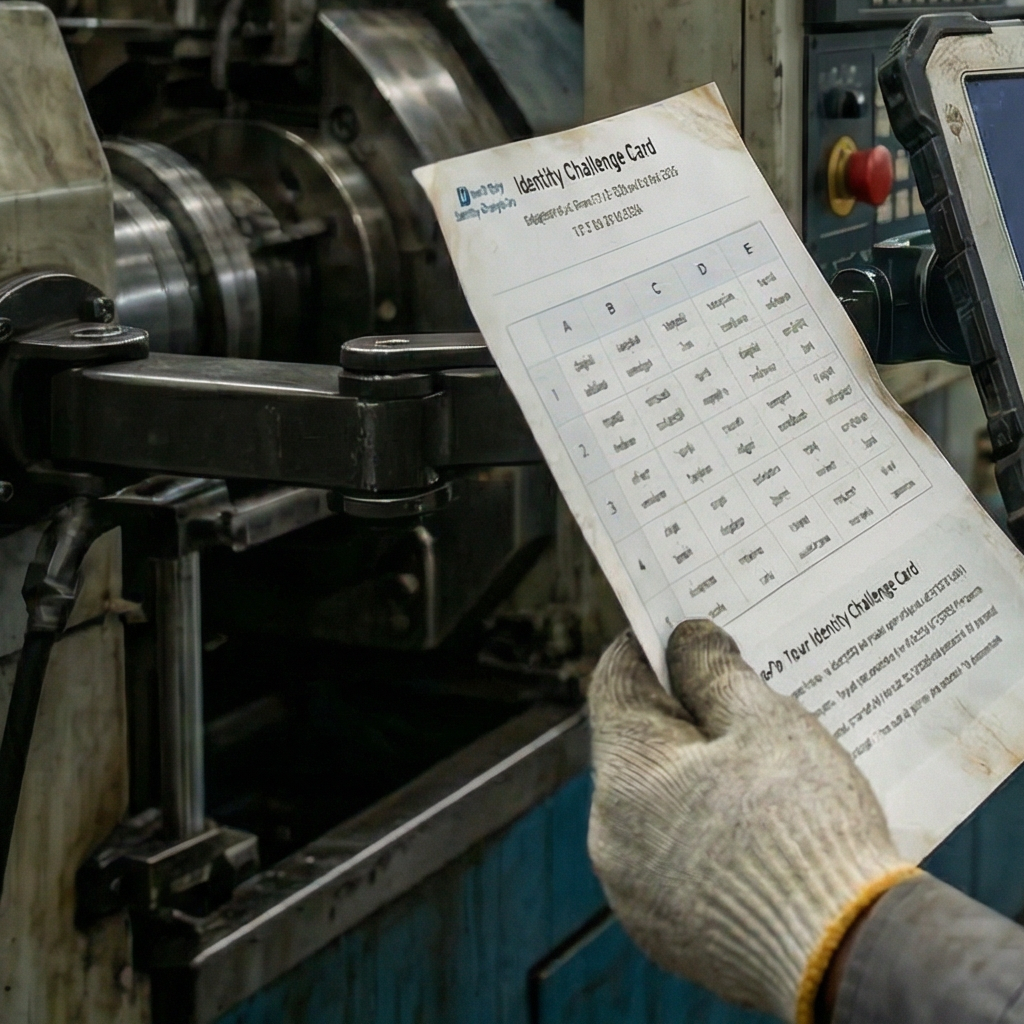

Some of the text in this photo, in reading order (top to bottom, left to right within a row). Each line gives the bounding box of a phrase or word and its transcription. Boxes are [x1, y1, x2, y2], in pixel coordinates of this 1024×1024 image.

[513, 137, 657, 195] Identity Challenge Card
[562, 242, 754, 333] A B C D E
[578, 443, 590, 458] 2
[808, 614, 852, 647] Identity
[847, 579, 898, 619] Challenge
[894, 560, 920, 586] Card
